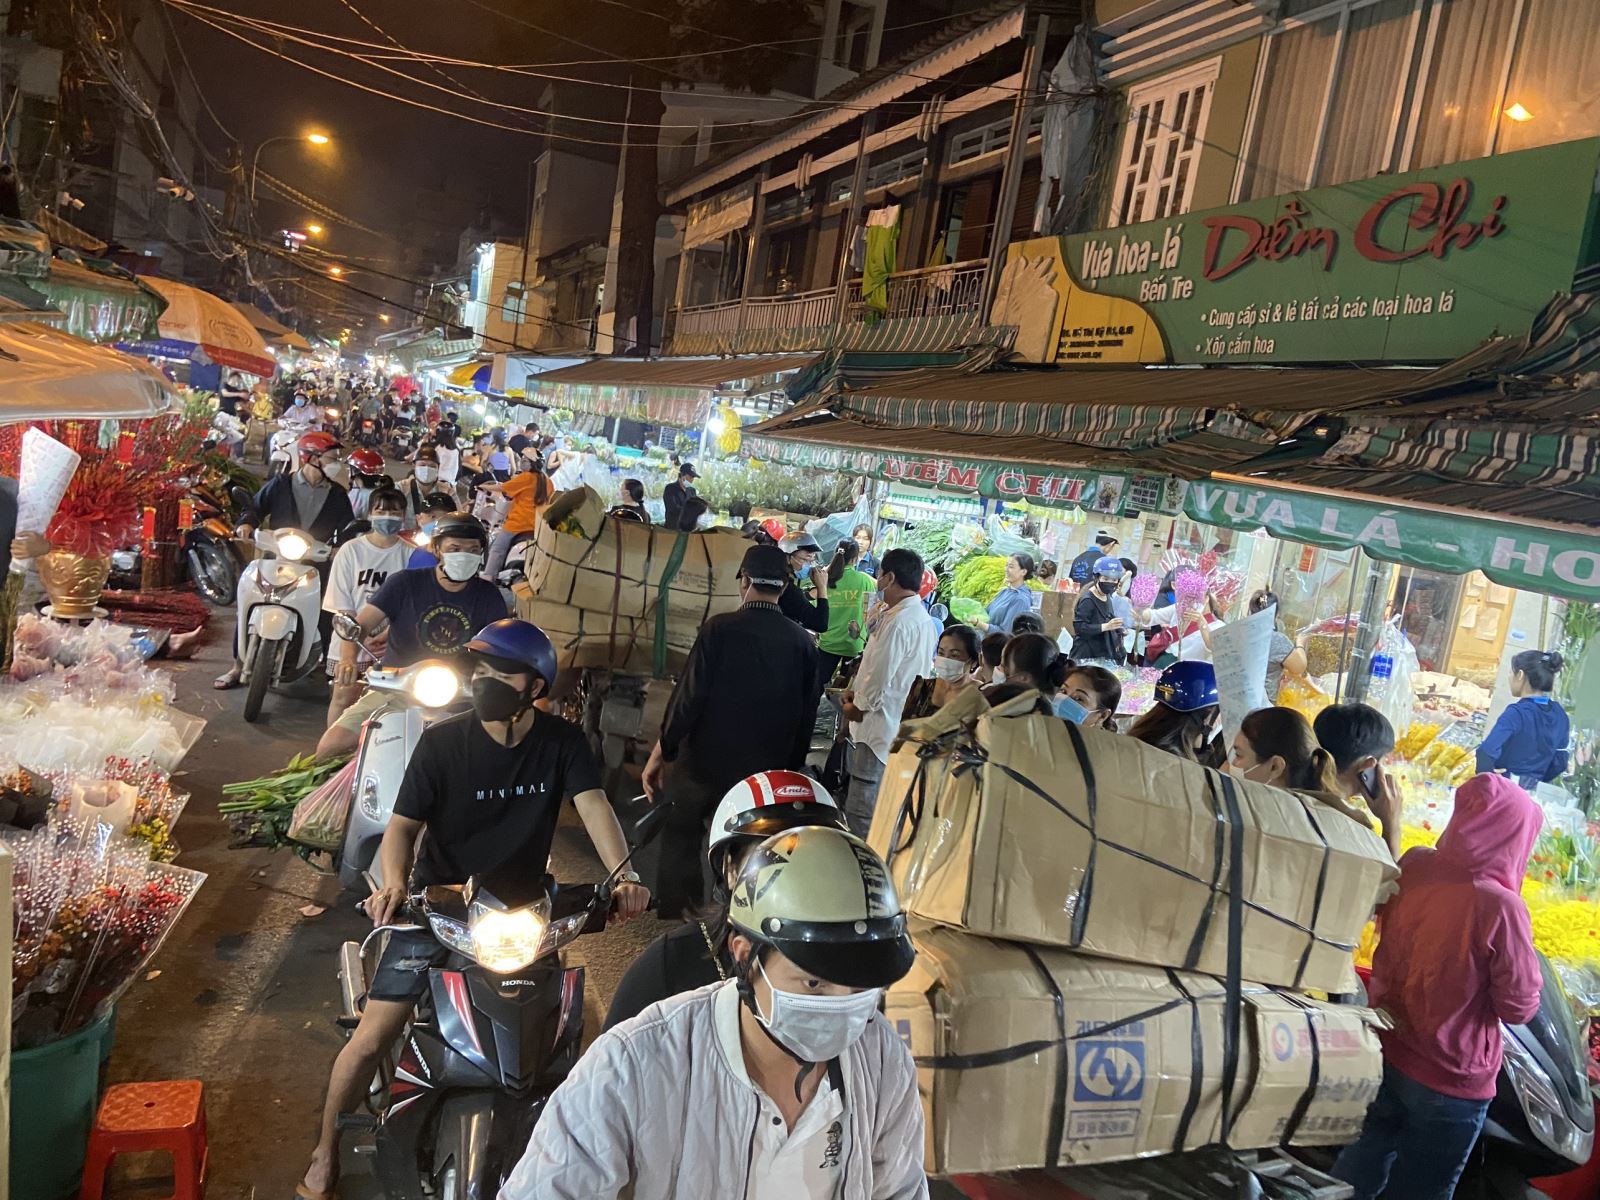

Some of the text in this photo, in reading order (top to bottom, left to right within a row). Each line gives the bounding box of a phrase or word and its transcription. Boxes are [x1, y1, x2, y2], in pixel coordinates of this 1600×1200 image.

[1354, 177, 1506, 262] Chi
[1082, 240, 1113, 289] Vựa
[1140, 275, 1193, 302] Bến Tre
[1209, 309, 1235, 329] Cung
[1237, 303, 1257, 328] cấp
[1273, 303, 1282, 323] &
[1323, 296, 1339, 319] cả
[1342, 296, 1367, 318] các
[1372, 296, 1399, 320] loại
[1403, 293, 1433, 314] hoa
[1438, 289, 1455, 313] lá
[1204, 335, 1226, 358] Xốp
[1253, 336, 1275, 353] hoa
[1193, 486, 1296, 528] VỰA
[1319, 507, 1402, 549] LÁ
[501, 979, 536, 987] HONDA
[410, 1036, 431, 1080] HONDA
